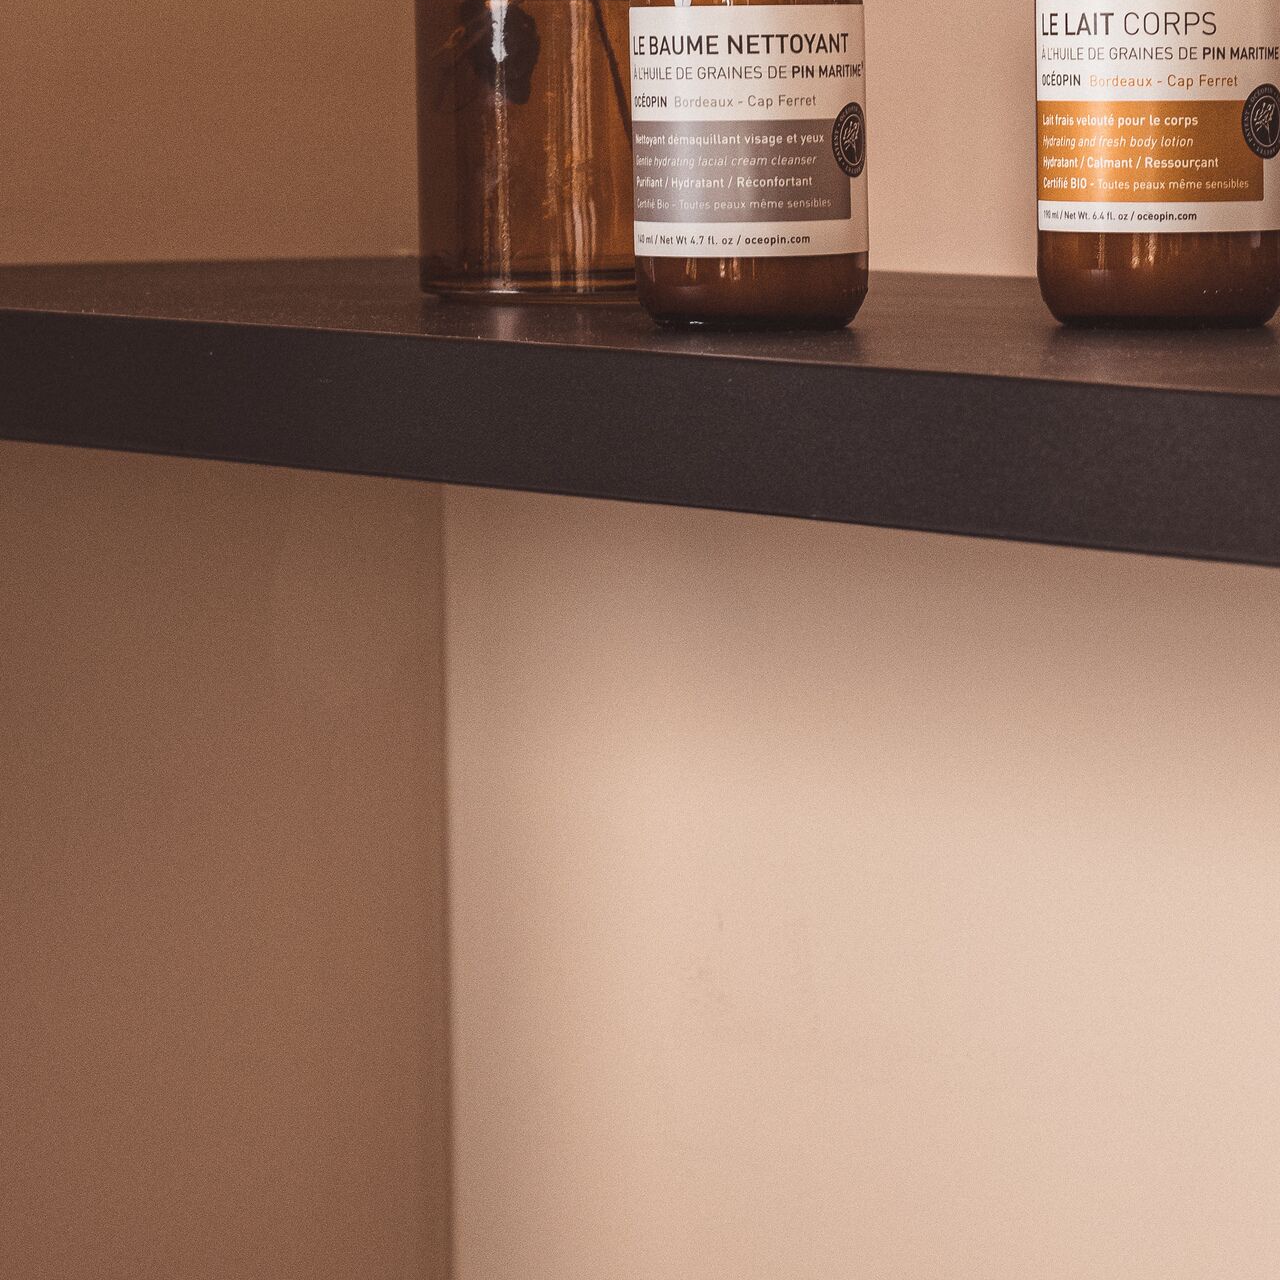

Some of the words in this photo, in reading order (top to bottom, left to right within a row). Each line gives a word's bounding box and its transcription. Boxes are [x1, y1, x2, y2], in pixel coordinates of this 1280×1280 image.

[1042, 13, 1058, 36] LE
[1065, 12, 1114, 36] LAIT
[1124, 11, 1217, 36] CORPS
[634, 36, 645, 55] LE
[649, 35, 719, 55] BAUME
[728, 33, 849, 54] NETTOYANT
[1048, 47, 1084, 60] L'HUILE
[1088, 47, 1104, 60] DE
[1109, 47, 1174, 60] GRAINES
[1178, 47, 1198, 60] DE
[1202, 47, 1226, 60] PIN
[638, 66, 672, 80] L'HUILE
[676, 66, 692, 80] DE
[697, 66, 762, 80] GRAINES
[768, 66, 787, 79] DE
[792, 65, 814, 78] PIN
[1042, 71, 1080, 86] OCÉOPIN
[1090, 74, 1152, 87] Bordeaux
[1168, 74, 1194, 90] Cap
[1199, 74, 1238, 86] Ferret
[634, 93, 668, 108] OCÉOPIN
[674, 96, 734, 108] Bordeaux
[748, 95, 773, 110] Cap
[778, 94, 816, 106] Ferret
[1042, 114, 1054, 126] Lait
[1056, 114, 1074, 126] frais
[1076, 114, 1114, 126] velouté
[1118, 116, 1146, 128] pour
[1150, 114, 1160, 126] le
[1164, 116, 1198, 128] corps
[636, 134, 665, 147] Nettoyant
[668, 134, 741, 147] démaquillant
[744, 134, 782, 147] visage
[786, 134, 798, 144] et
[800, 134, 825, 146] yeux
[1042, 135, 1076, 150] Hydrating
[1078, 136, 1096, 147] and
[1098, 136, 1126, 147] fresh
[1130, 136, 1158, 150] body
[1160, 136, 1194, 147] lotion
[654, 156, 694, 170] hydrating
[698, 155, 728, 166] facial
[731, 157, 768, 166] cream
[771, 155, 817, 166] cleanser
[1043, 156, 1078, 169] Hydratant
[1087, 156, 1132, 168] Calmant
[1144, 156, 1219, 171] Ressourçant
[636, 176, 662, 188] Purifiant
[672, 177, 724, 190] Hydratant
[737, 176, 812, 188] Réconfortant
[1044, 177, 1068, 188] Certifié
[1070, 178, 1086, 188] BIO
[1098, 180, 1130, 190] Toutes
[1133, 181, 1166, 192] peaux
[1168, 179, 1202, 190] même
[1206, 178, 1249, 189] sensibles
[657, 199, 670, 209] Bio
[680, 200, 710, 209] Toutes
[714, 201, 746, 211] peaux
[750, 198, 784, 209] même
[788, 198, 832, 208] sensibles
[1064, 211, 1076, 220] Net
[1106, 211, 1116, 220] fl.
[1137, 212, 1197, 222] oceopin.com
[660, 236, 673, 244] Net
[690, 236, 704, 244] 4.7
[708, 235, 718, 244] fl.
[744, 235, 810, 246] oceopin.com
